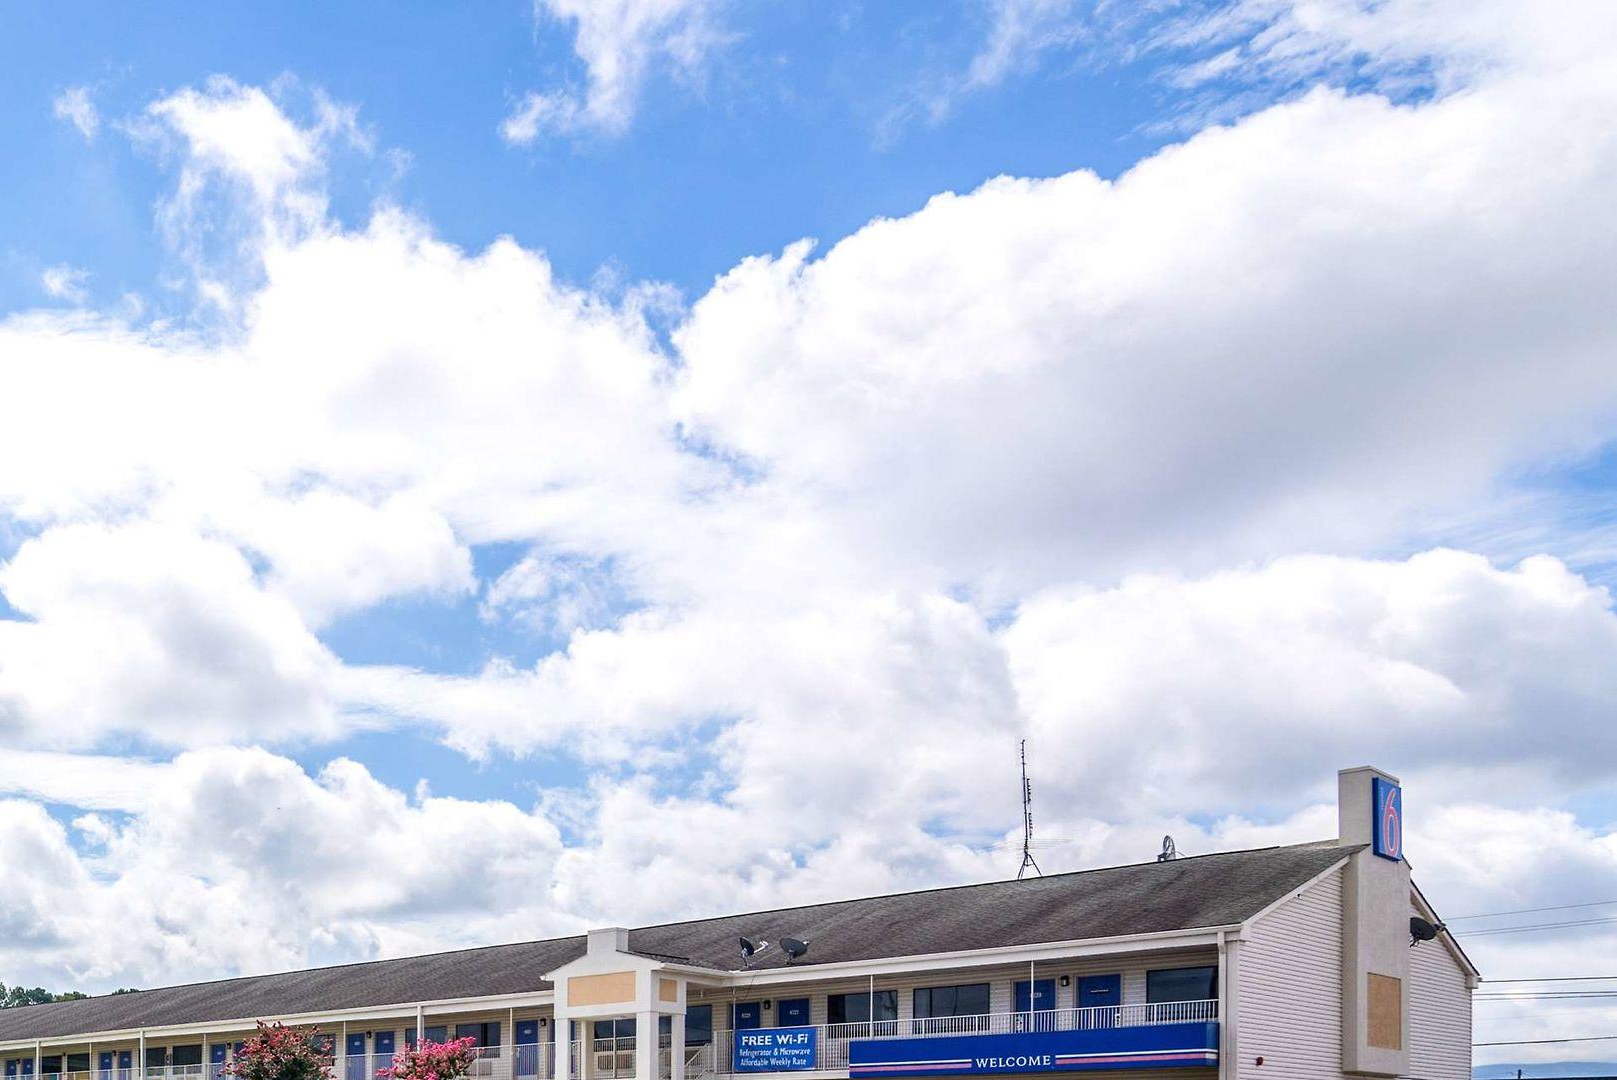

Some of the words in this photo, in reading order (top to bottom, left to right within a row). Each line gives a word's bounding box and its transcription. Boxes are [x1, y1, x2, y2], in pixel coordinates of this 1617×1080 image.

[1383, 788, 1399, 857] 6
[742, 1035, 773, 1046] FREE
[776, 1033, 809, 1045] Wi-Fi
[779, 1047, 811, 1056] Microwave
[769, 1057, 791, 1067] Weekly
[792, 1057, 807, 1066] Rate
[976, 1055, 1051, 1068] WELCOME
